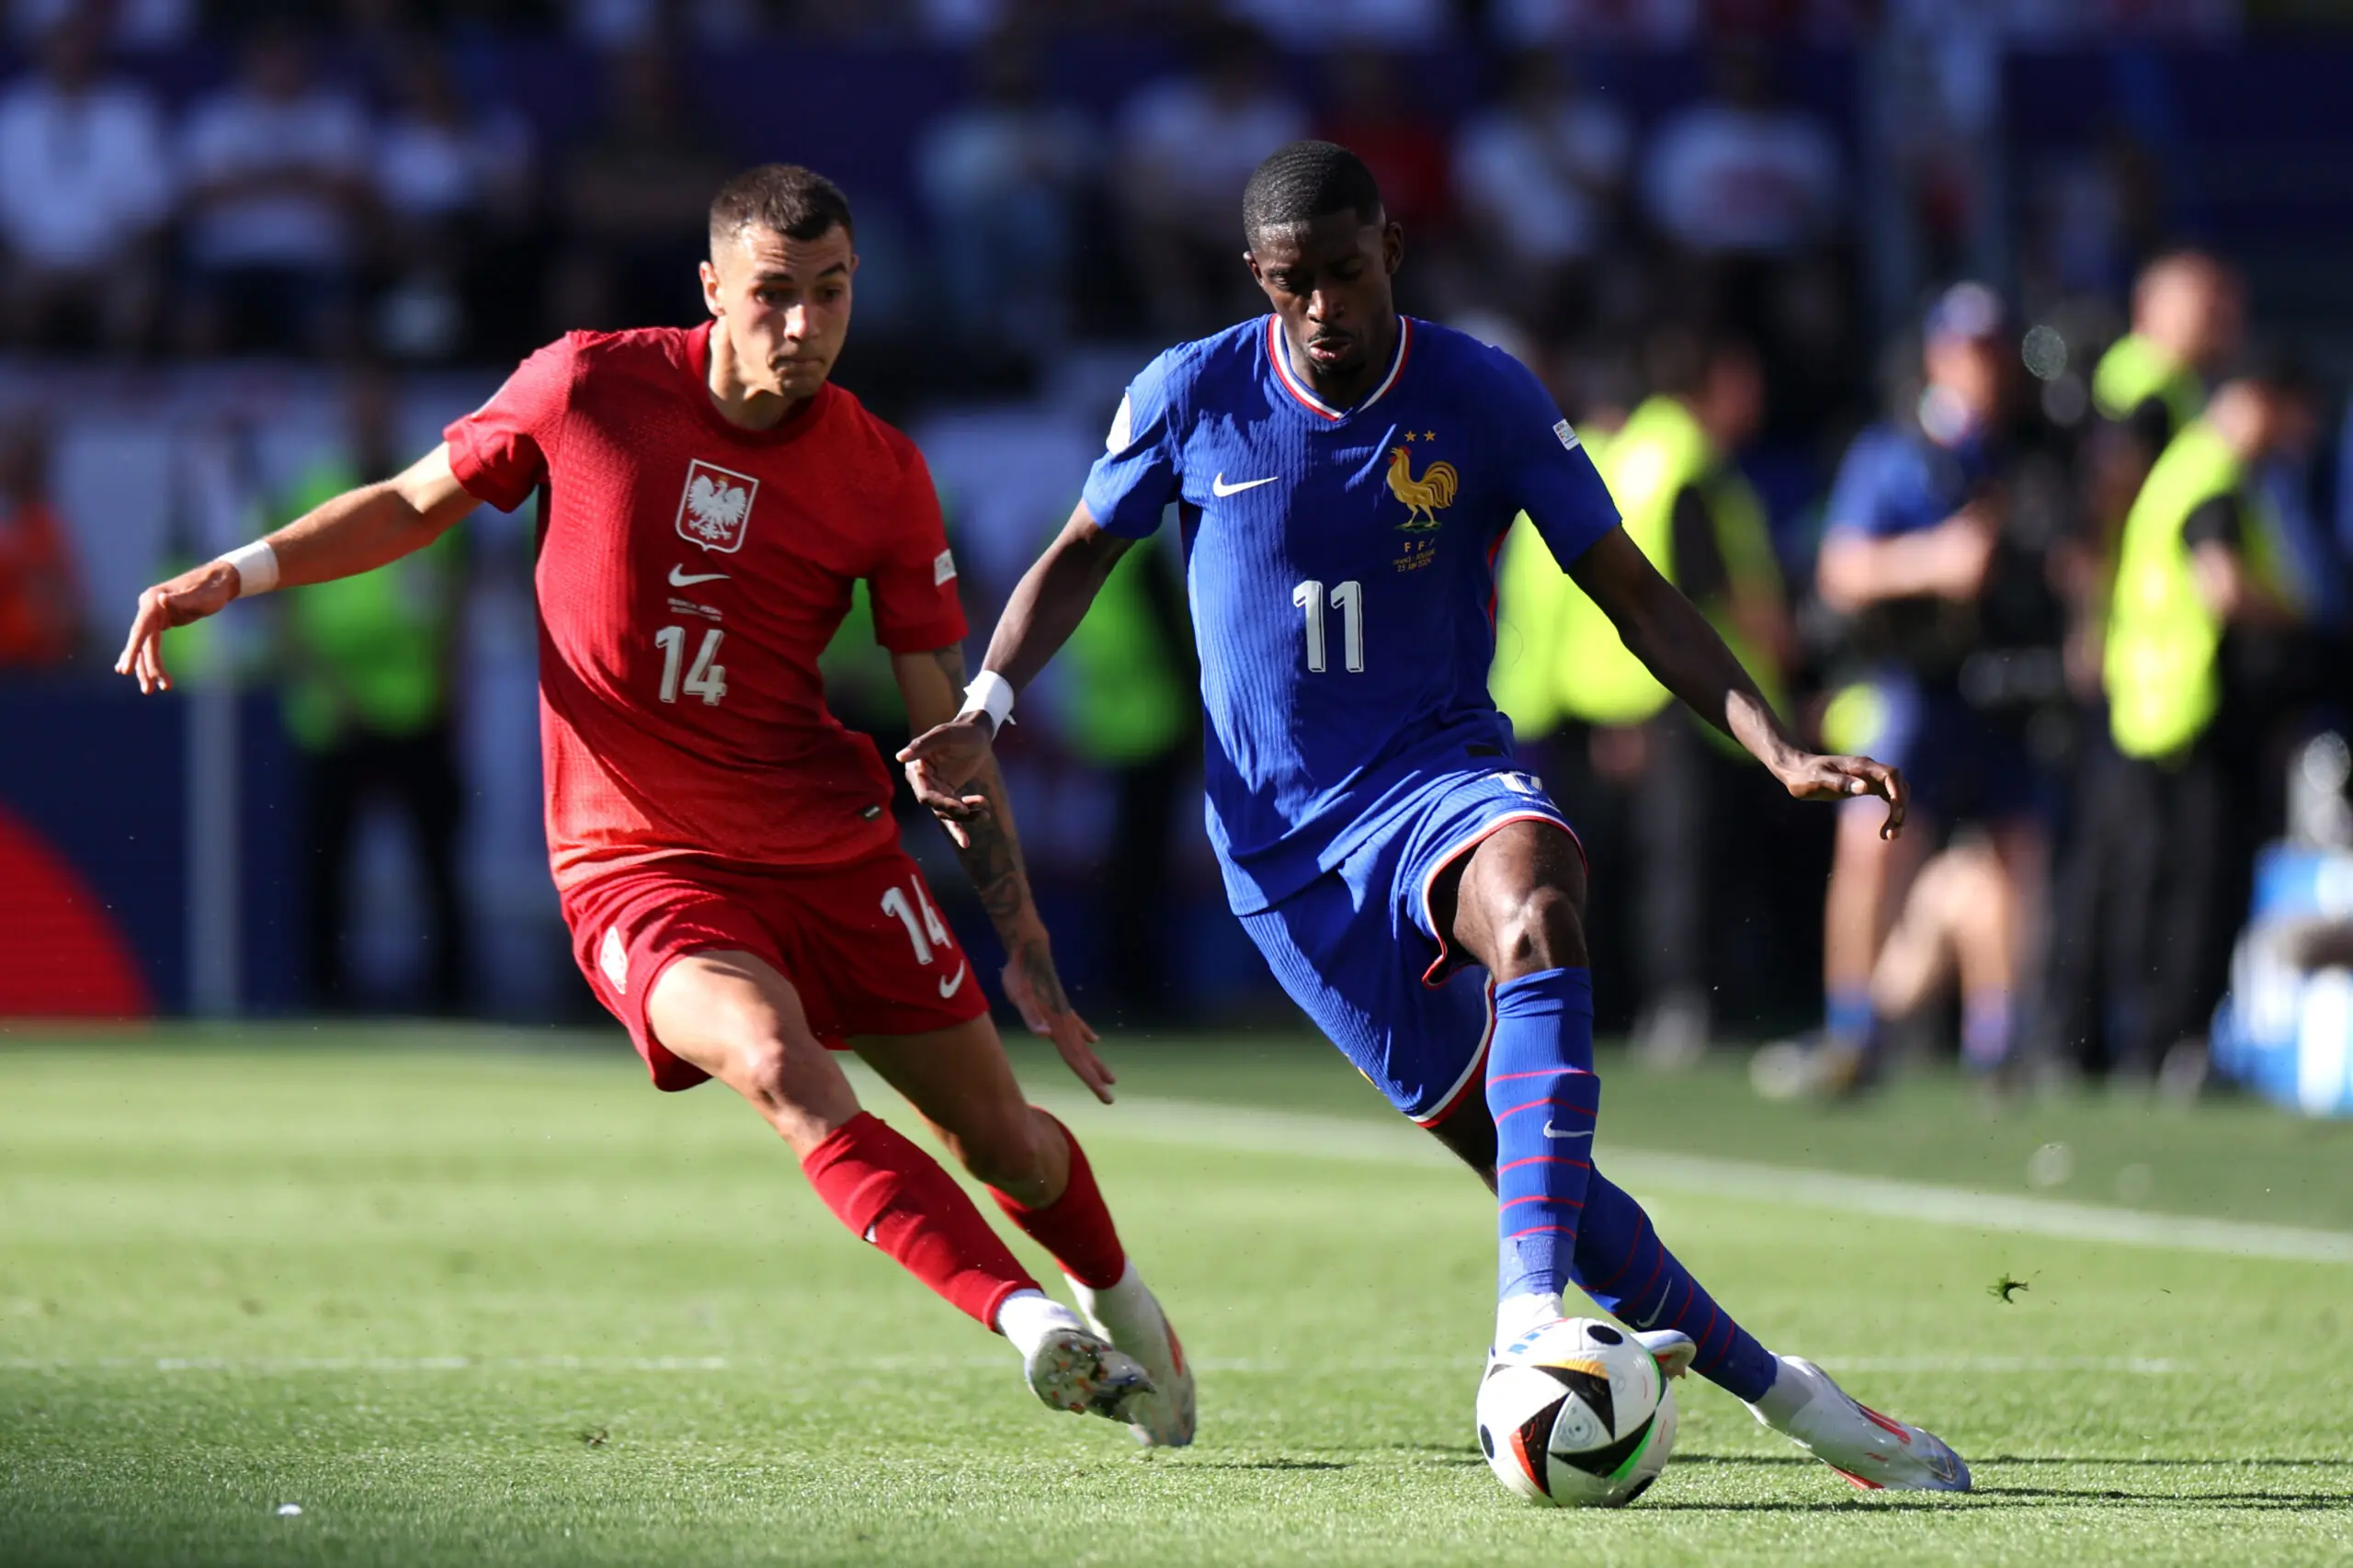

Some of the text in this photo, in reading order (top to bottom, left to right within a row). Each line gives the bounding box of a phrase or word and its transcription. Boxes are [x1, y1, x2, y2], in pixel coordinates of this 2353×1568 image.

[655, 626, 727, 706] 14
[1292, 580, 1364, 673] 11
[881, 874, 952, 965] 14
